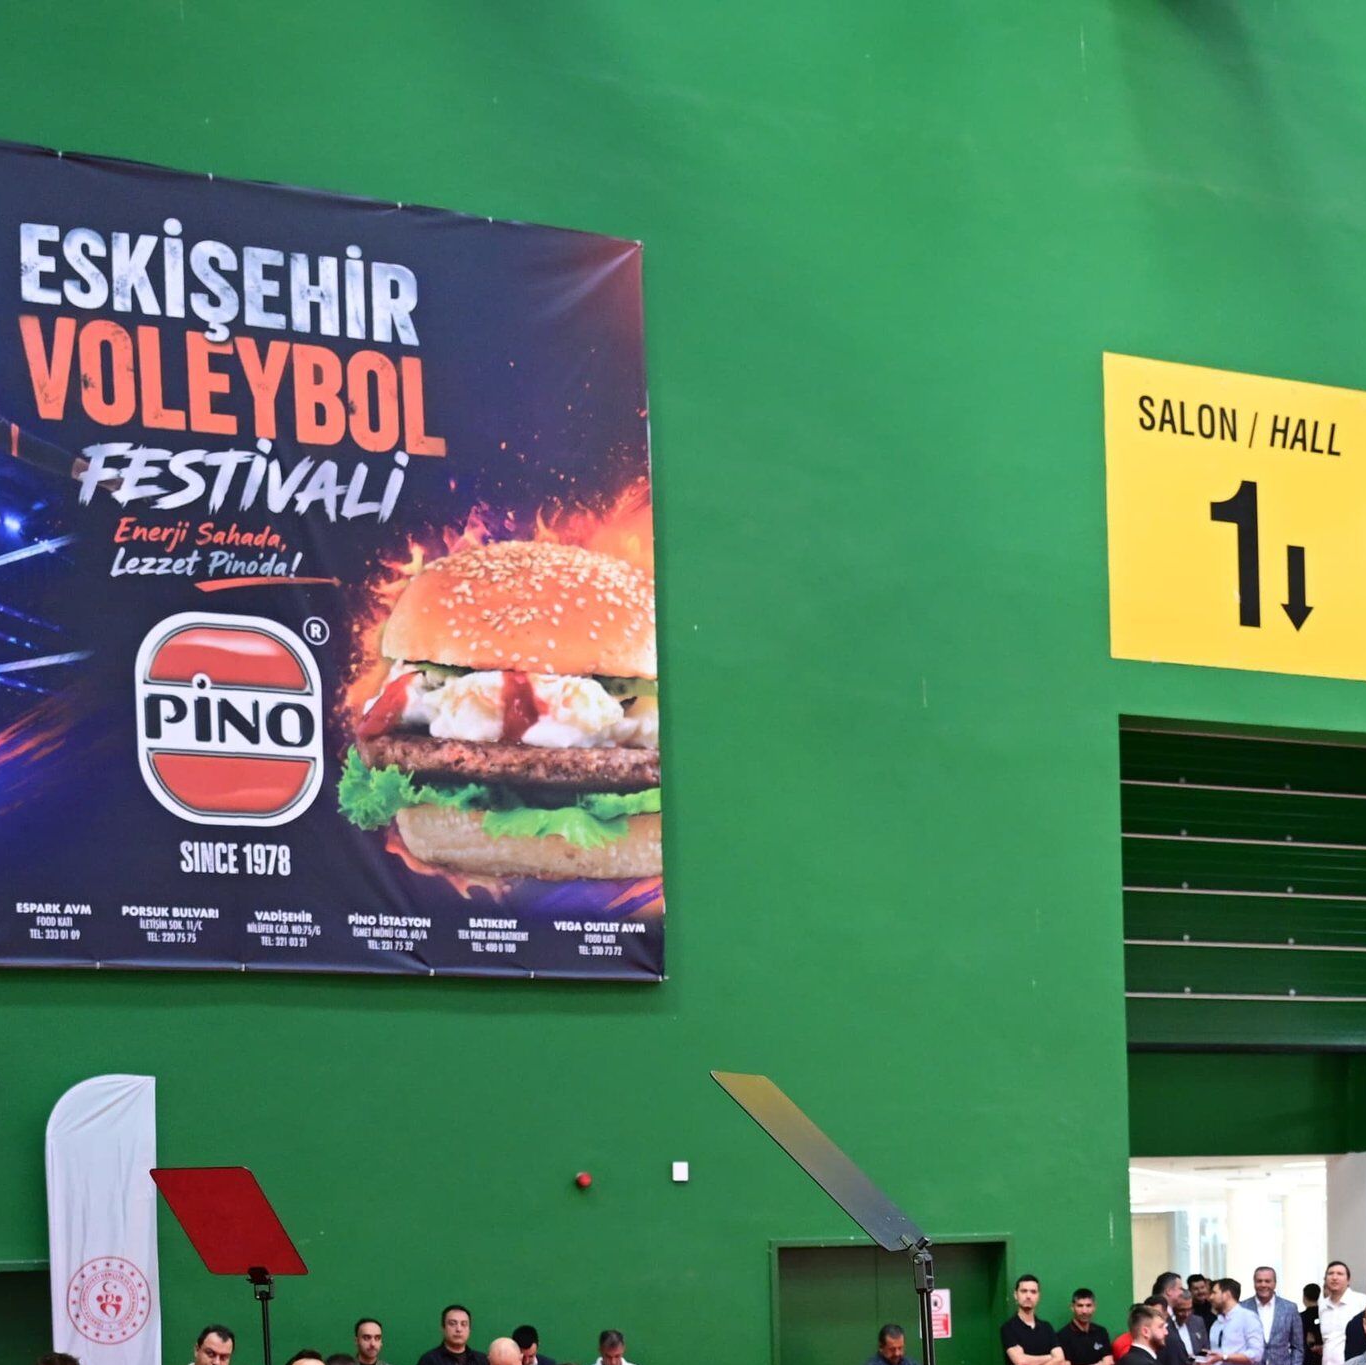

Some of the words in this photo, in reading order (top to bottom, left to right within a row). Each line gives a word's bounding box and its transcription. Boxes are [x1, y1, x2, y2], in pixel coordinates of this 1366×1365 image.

[20, 218, 419, 346] ESKİŞEHİR
[18, 314, 446, 457] VOLEYBOL
[1138, 395, 1237, 443] SALON
[1269, 414, 1342, 456] HALL
[77, 437, 410, 524] FESTİVALİ
[113, 516, 190, 553] Enerji
[195, 522, 287, 552] Sahada,
[1210, 480, 1262, 628] 1
[110, 547, 202, 577] Lezzet
[179, 840, 239, 875] SINCE
[242, 843, 291, 876] 1978
[16, 902, 61, 914] ESPARK
[64, 904, 92, 915] AVM
[121, 905, 170, 917] PORSUK
[172, 906, 219, 918] BULVARI
[36, 916, 56, 927] FOOD
[58, 917, 73, 927] KATI
[254, 909, 313, 925] VADİŞEHİR
[348, 912, 377, 925] PİNO
[379, 913, 431, 928] İSTASYON
[469, 918, 517, 930] BATIKENT
[553, 920, 582, 932] VEGA
[584, 922, 620, 933] OUTLET
[621, 923, 646, 933] AVM
[30, 929, 44, 939] TEL:
[146, 932, 161, 942] TEL:
[177, 932, 187, 943] 75
[187, 933, 196, 943] 75
[260, 936, 275, 947] TEL:
[367, 939, 381, 949] TEL:
[471, 942, 484, 952] TEL:
[578, 945, 591, 956] TEL:
